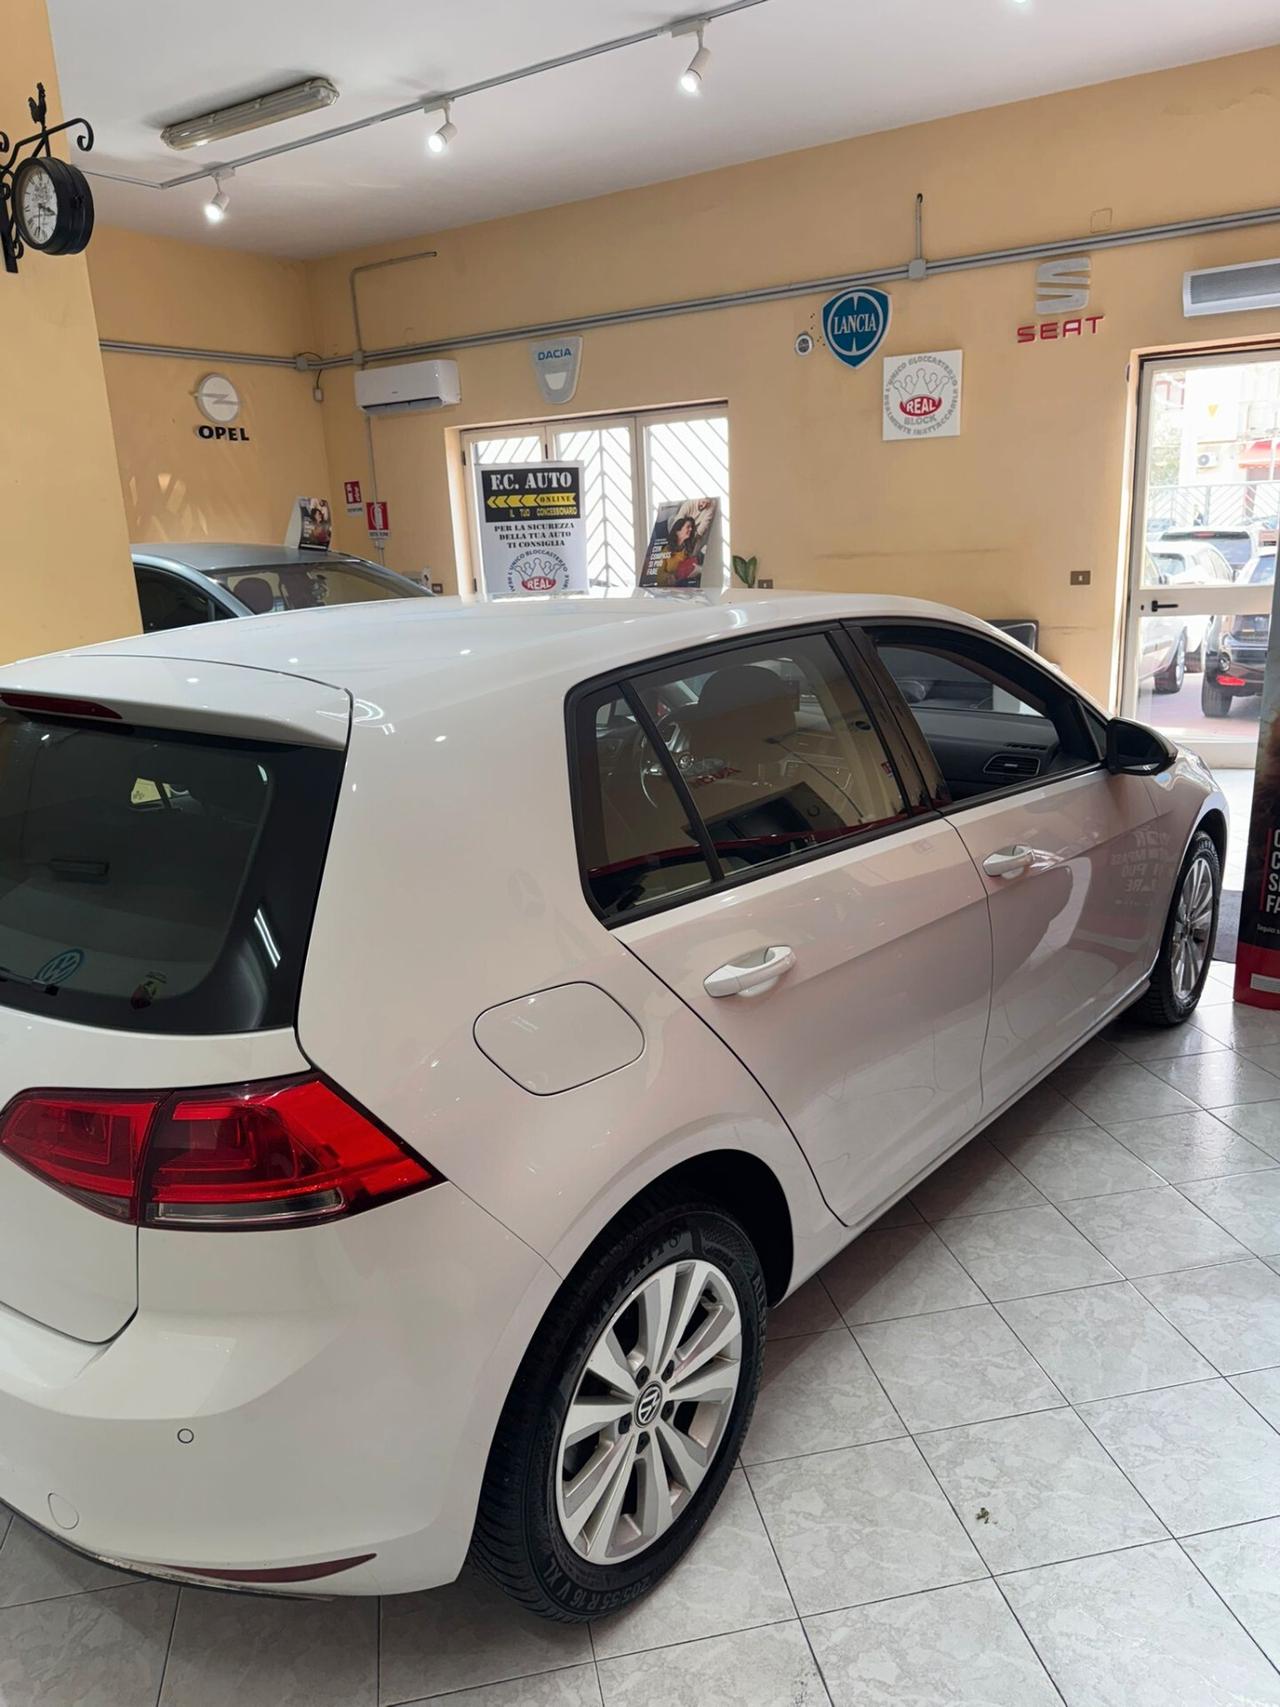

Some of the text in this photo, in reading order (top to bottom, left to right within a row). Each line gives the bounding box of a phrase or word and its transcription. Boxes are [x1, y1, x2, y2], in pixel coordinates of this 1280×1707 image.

[833, 313, 876, 335] LANCIA
[1017, 315, 1104, 343] SEAT
[537, 347, 572, 361] DACIA
[906, 398, 937, 414] REAL
[198, 425, 250, 441] OPEL
[490, 471, 572, 491] F.C. AUTO
[540, 495, 571, 503] ONLINE
[494, 524, 512, 532] PER
[527, 522, 575, 530] SICUREZZA
[499, 530, 571, 541] DELLA TUA AUTO
[518, 540, 565, 549] CONSIGLIA
[527, 578, 552, 589] REAL
